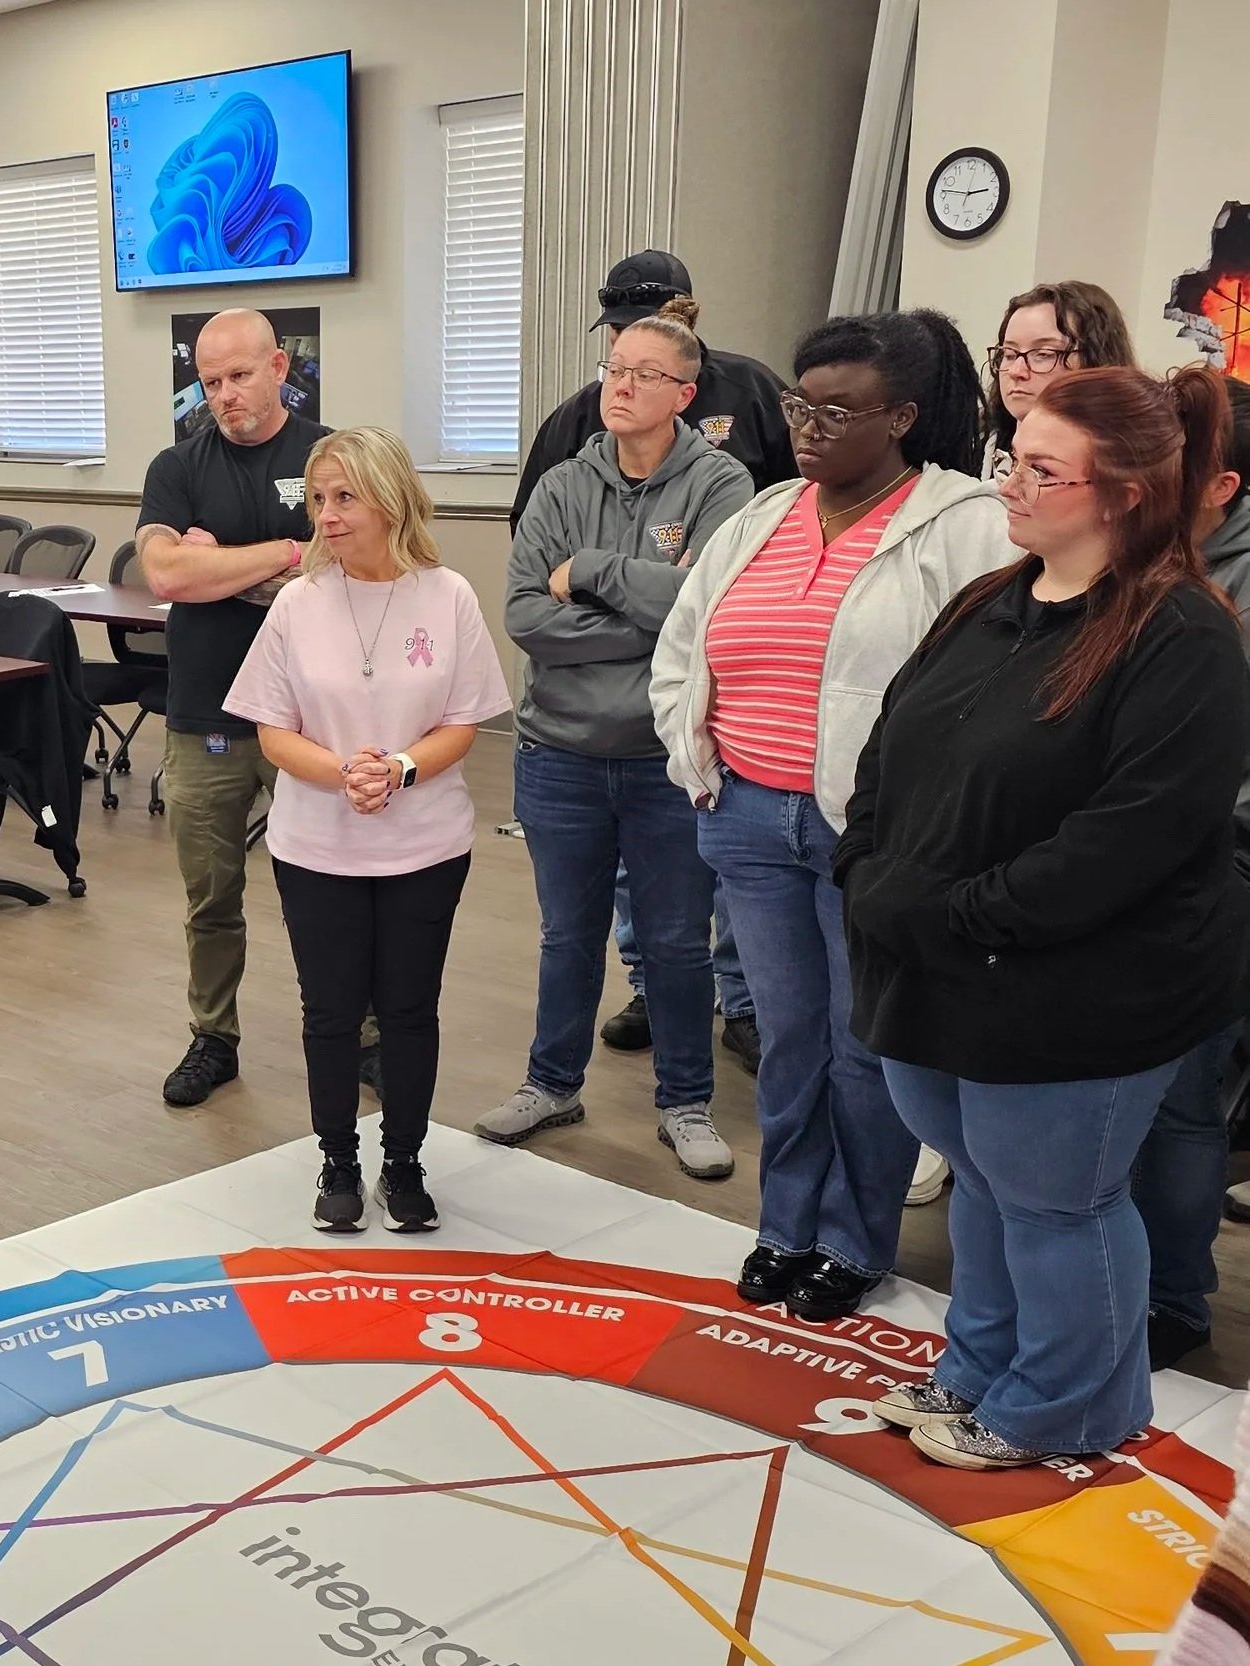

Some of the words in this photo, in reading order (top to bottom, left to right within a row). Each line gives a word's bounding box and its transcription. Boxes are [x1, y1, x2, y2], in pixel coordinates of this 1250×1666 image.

[954, 165, 962, 176] 11
[966, 159, 977, 171] 12
[943, 175, 956, 187] 10
[990, 171, 997, 183] 2
[943, 203, 950, 215] 8
[986, 202, 994, 212] 4
[953, 214, 960, 226] 7
[964, 217, 972, 228] 6
[977, 213, 983, 225] 5
[286, 1285, 398, 1304] ACTIVE
[409, 1287, 626, 1322] CONTROLLER
[63, 1295, 229, 1333] VISIONARY
[418, 1312, 483, 1352] 8
[756, 1301, 948, 1363] ATION
[696, 1324, 868, 1380] ADAPTIVE
[47, 1339, 111, 1388] 7
[797, 1397, 892, 1435] 9
[1127, 1509, 1213, 1570] STRIC
